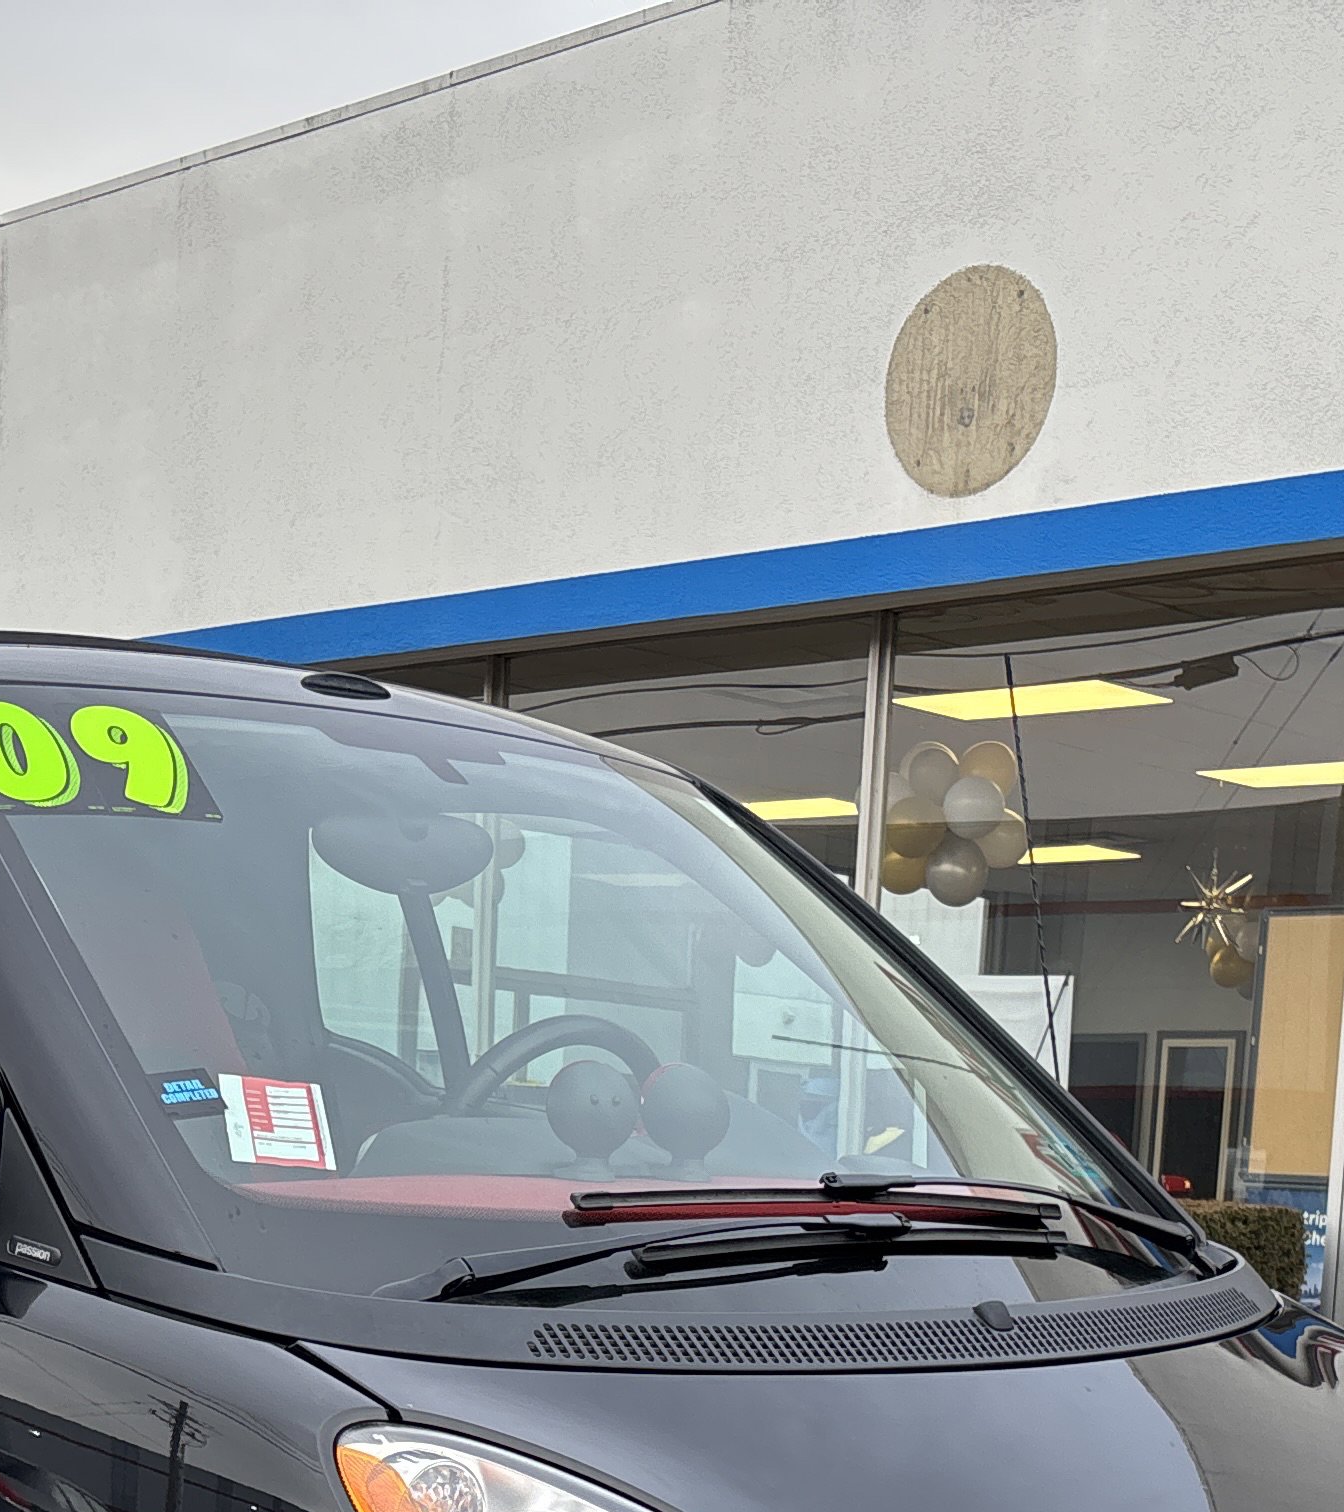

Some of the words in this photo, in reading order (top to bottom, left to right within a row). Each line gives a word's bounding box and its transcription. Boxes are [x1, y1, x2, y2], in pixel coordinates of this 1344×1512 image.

[163, 1079, 205, 1093] DETAIL
[161, 1088, 219, 1105] COMPLETED
[15, 1242, 51, 1261] passion
